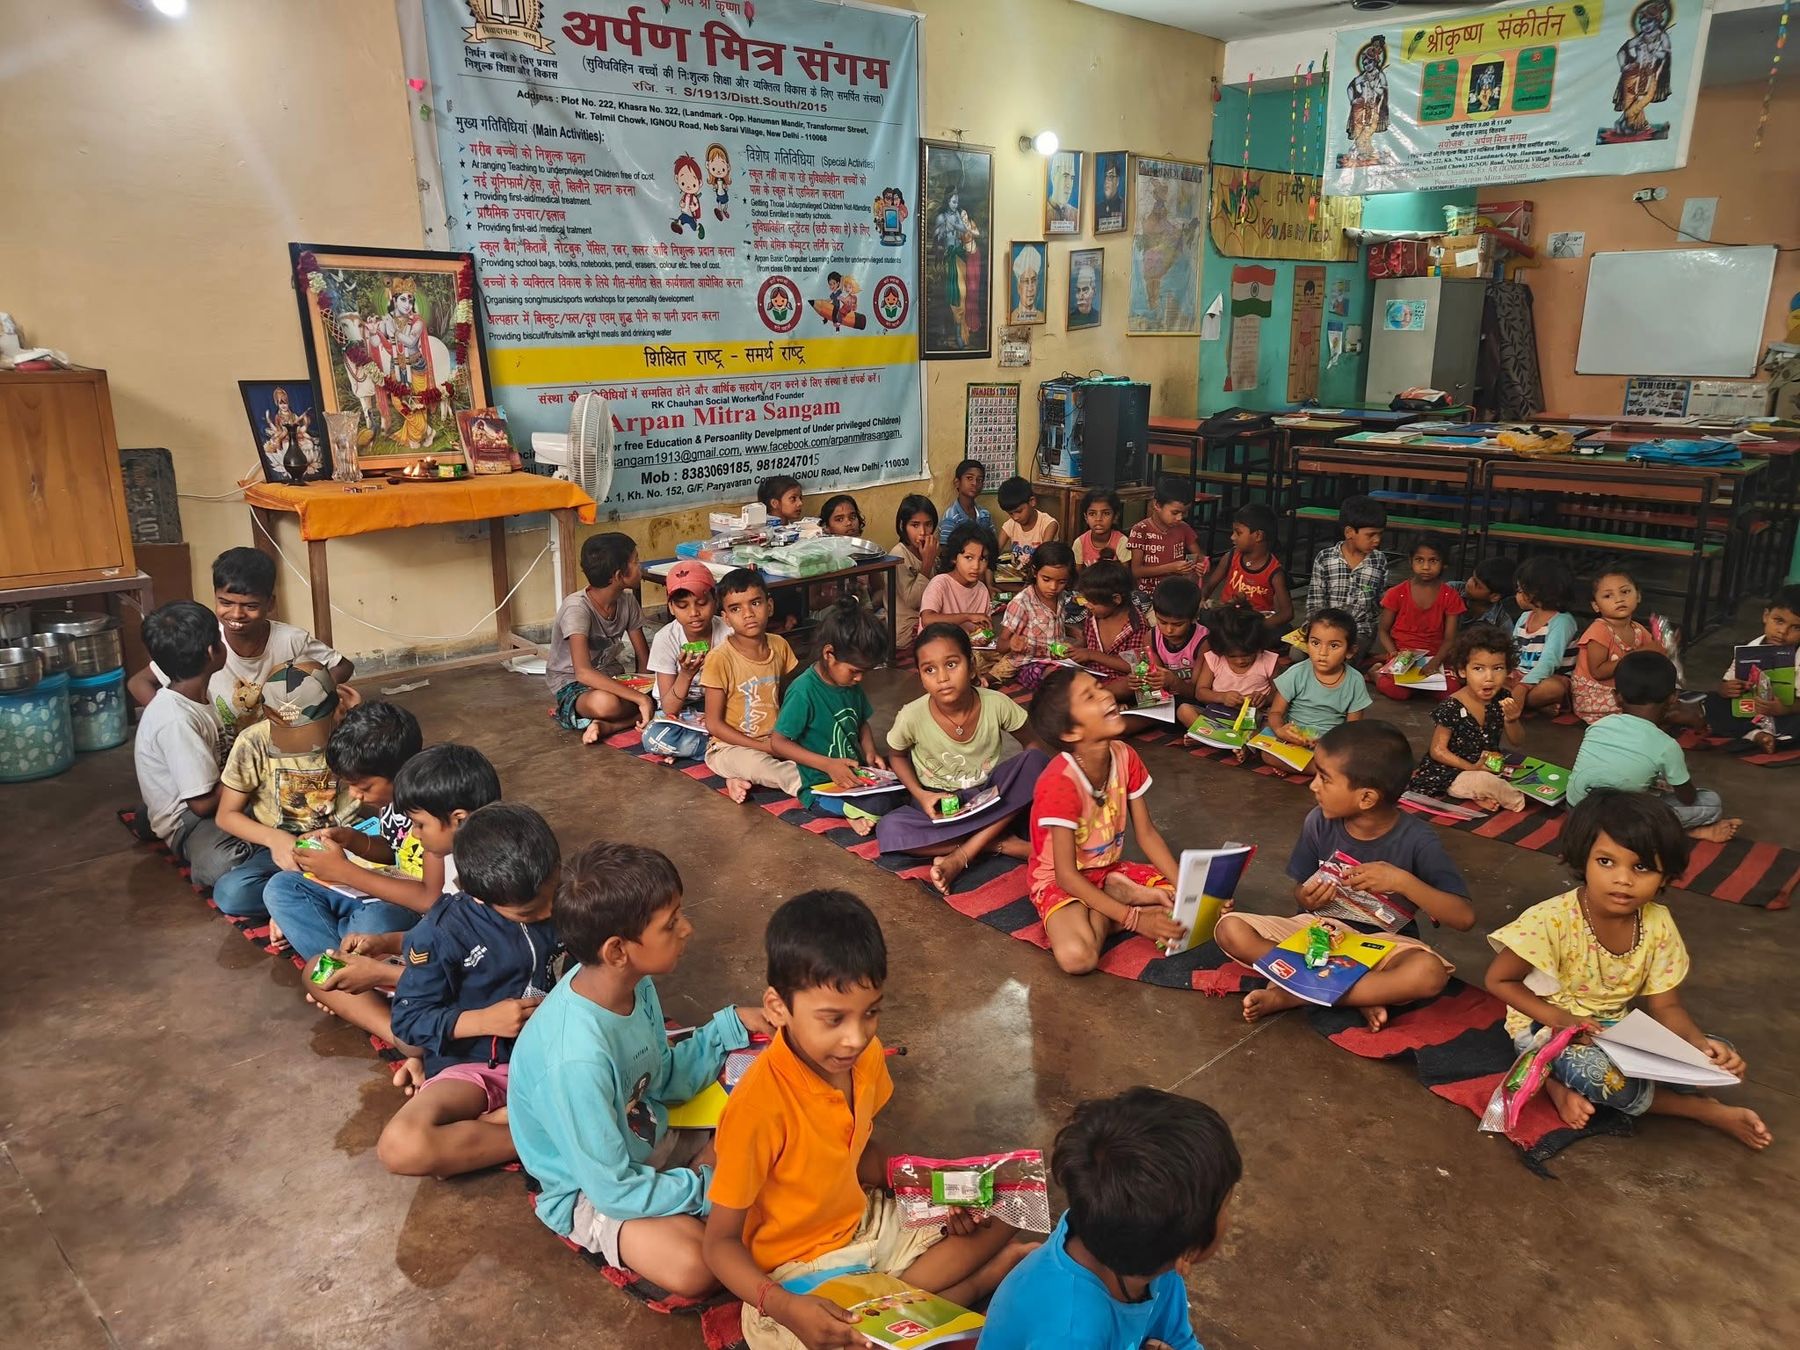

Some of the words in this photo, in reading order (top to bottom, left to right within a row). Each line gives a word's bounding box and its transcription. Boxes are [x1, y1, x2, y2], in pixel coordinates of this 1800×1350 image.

[1427, 22, 1485, 55] श्रीकृष्ण
[1497, 6, 1566, 39] संकीर्तन
[561, 6, 691, 62] अर्पण
[700, 20, 787, 76] मित्र
[793, 41, 890, 89] संगम
[496, 61, 516, 75] शिक्षा
[534, 66, 559, 80] विकास
[537, 58, 558, 69] प्रयास
[639, 64, 658, 77] बच्चों
[663, 67, 674, 79] की
[713, 72, 732, 87] शिक्षा
[736, 75, 749, 88] और
[784, 82, 807, 96] विकास
[821, 87, 834, 101] लिए
[837, 88, 860, 102] समर्पित
[632, 81, 659, 95] रजि.
[684, 86, 828, 113] S/1913/Distt.South/2015
[517, 90, 554, 103] Address
[561, 96, 579, 106] Plot
[582, 98, 597, 108] No.
[599, 100, 616, 111] 222,
[618, 102, 648, 113] Khasra
[649, 104, 663, 114] No.
[665, 106, 681, 117] 322,
[682, 108, 723, 120] (Landmark
[729, 113, 746, 123] Opp.
[747, 116, 780, 126] Hanuman
[781, 119, 806, 130] Mandir,
[807, 122, 846, 133] Transformer
[847, 126, 869, 136] Street,
[456, 116, 478, 134] मुख्य
[480, 116, 528, 136] गतिविधियां
[532, 123, 558, 139] (Main
[559, 126, 605, 146] Activities):
[618, 113, 649, 126] Chowk,
[650, 118, 677, 129] IGNOU
[679, 120, 702, 131] Road,
[703, 122, 718, 132] Neb
[720, 124, 739, 134] Sarai
[740, 127, 765, 137] Village,
[767, 129, 781, 138] New
[782, 130, 800, 140] Delhi
[805, 133, 828, 143] 110068
[469, 141, 492, 157] गरीब
[495, 143, 518, 160] बच्चों
[522, 145, 533, 160] को
[535, 146, 564, 166] निशुल्क
[746, 145, 770, 164] विशेष
[821, 156, 847, 169] (Special
[472, 161, 507, 173] Arranging
[509, 162, 538, 174] Teaching
[547, 166, 594, 179] underprivileged
[595, 169, 620, 179] Children
[473, 172, 487, 188] नई
[567, 178, 591, 194] खिलौने
[594, 184, 612, 195] प्रदान
[615, 185, 636, 197] करना
[475, 193, 508, 204] Providing
[562, 197, 593, 206] treatment.
[823, 202, 844, 211] Children
[769, 210, 789, 219] Enrolled
[812, 212, 832, 220] schools.
[477, 222, 511, 234] Providing
[512, 223, 538, 233] first-aid
[480, 241, 500, 257] स्कूल
[718, 247, 736, 258] करना
[481, 258, 514, 269] Providing
[516, 259, 538, 268] school
[539, 260, 557, 269] bags,
[559, 260, 580, 269] books,
[581, 260, 614, 270] notebooks,
[482, 273, 506, 288] बच्चों
[522, 274, 555, 289] व्यक्तित्व
[558, 274, 582, 289] विकास
[725, 278, 744, 289] करना
[485, 295, 523, 306] Organising
[584, 296, 616, 305] workshops
[626, 295, 657, 305] personality
[658, 295, 694, 304] development
[701, 311, 720, 321] करना
[489, 331, 522, 342] Providing
[601, 329, 620, 338] meals
[632, 329, 656, 339] drinking
[643, 345, 687, 368] शिक्षित
[693, 349, 724, 369] राष्ट्र
[744, 341, 774, 364] समर्थ
[779, 345, 806, 365] राष्ट्र
[538, 392, 563, 405] संस्था
[712, 381, 736, 395] आर्थिक
[651, 401, 665, 410] RK
[667, 400, 703, 409] Chauhan
[706, 397, 730, 406] Social
[776, 391, 805, 401] Founder
[610, 412, 686, 438] Arpan
[693, 403, 757, 427] Mitra
[763, 401, 842, 423] Sangam
[624, 441, 644, 451] free
[646, 437, 693, 450] Education
[695, 436, 702, 445] &
[704, 431, 753, 445] Persoanlity
[754, 427, 801, 440] Develpment
[812, 423, 835, 433] Under
[836, 418, 872, 432] privileged
[872, 415, 901, 428] Children)
[627, 490, 645, 501] Kh.
[647, 489, 663, 499] No.
[666, 486, 685, 497] 152,
[707, 478, 752, 492] Paryavaran
[821, 467, 842, 478] Road,
[844, 465, 860, 474] New
[862, 462, 880, 472] Delhi
[884, 458, 909, 469] 110030
[641, 472, 670, 486] Mob
[681, 460, 753, 482] 8383069185,
[756, 452, 821, 472] 9818247015
